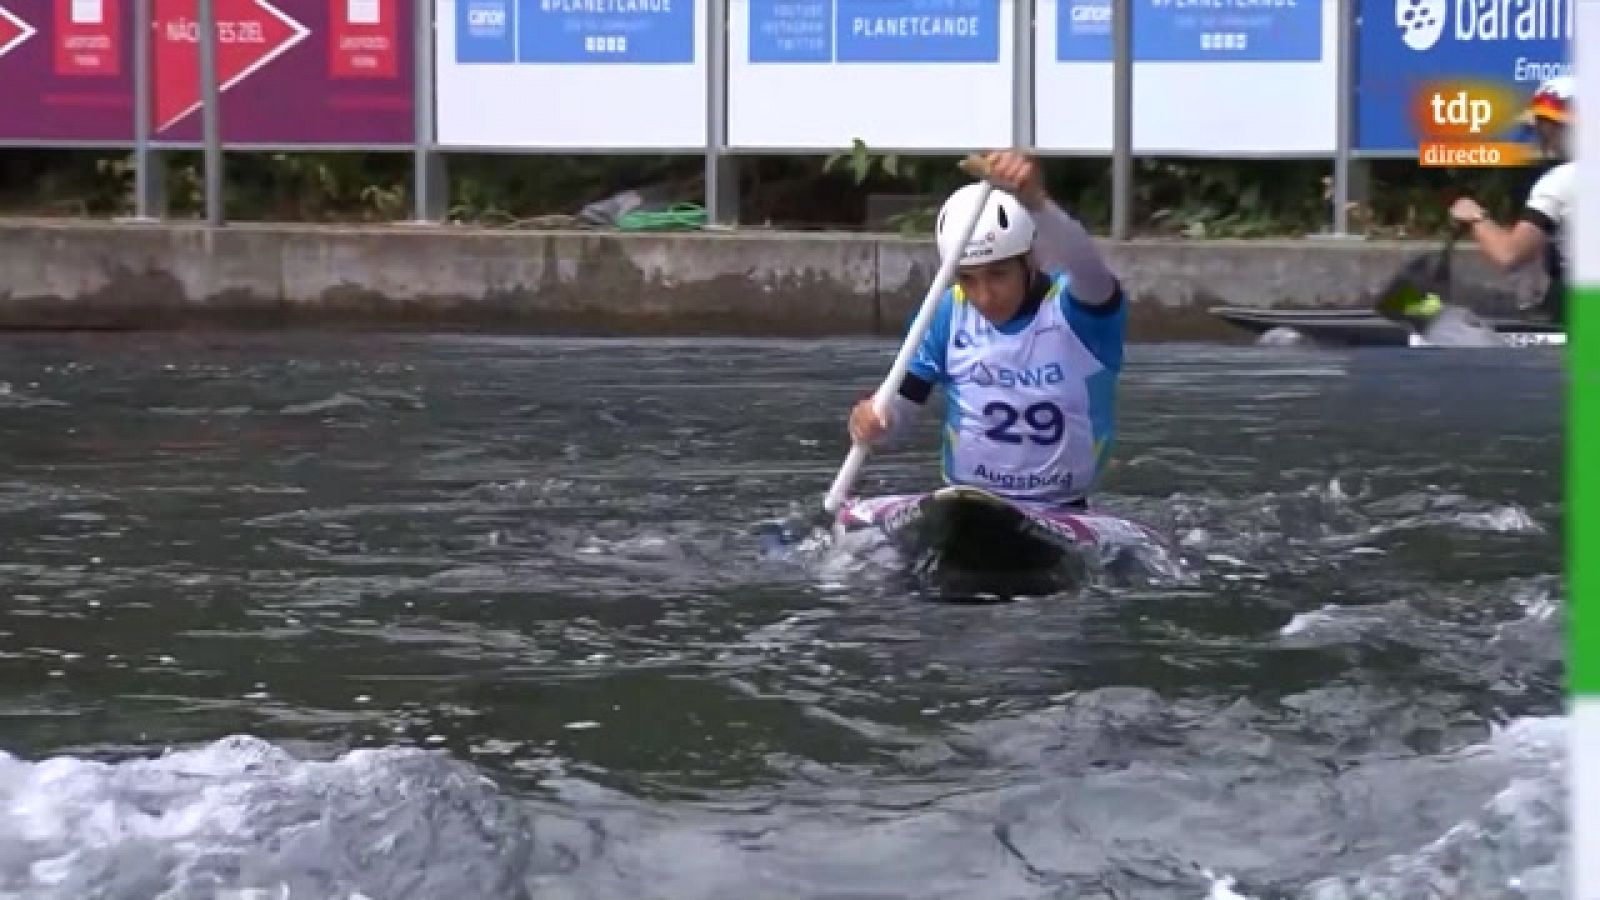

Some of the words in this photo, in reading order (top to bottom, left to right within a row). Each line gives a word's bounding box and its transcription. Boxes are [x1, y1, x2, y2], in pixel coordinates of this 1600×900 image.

[852, 17, 980, 36] PLANETCANOE
[1454, 0, 1574, 40] baram
[999, 363, 1065, 388] swa
[983, 401, 1066, 445] 29
